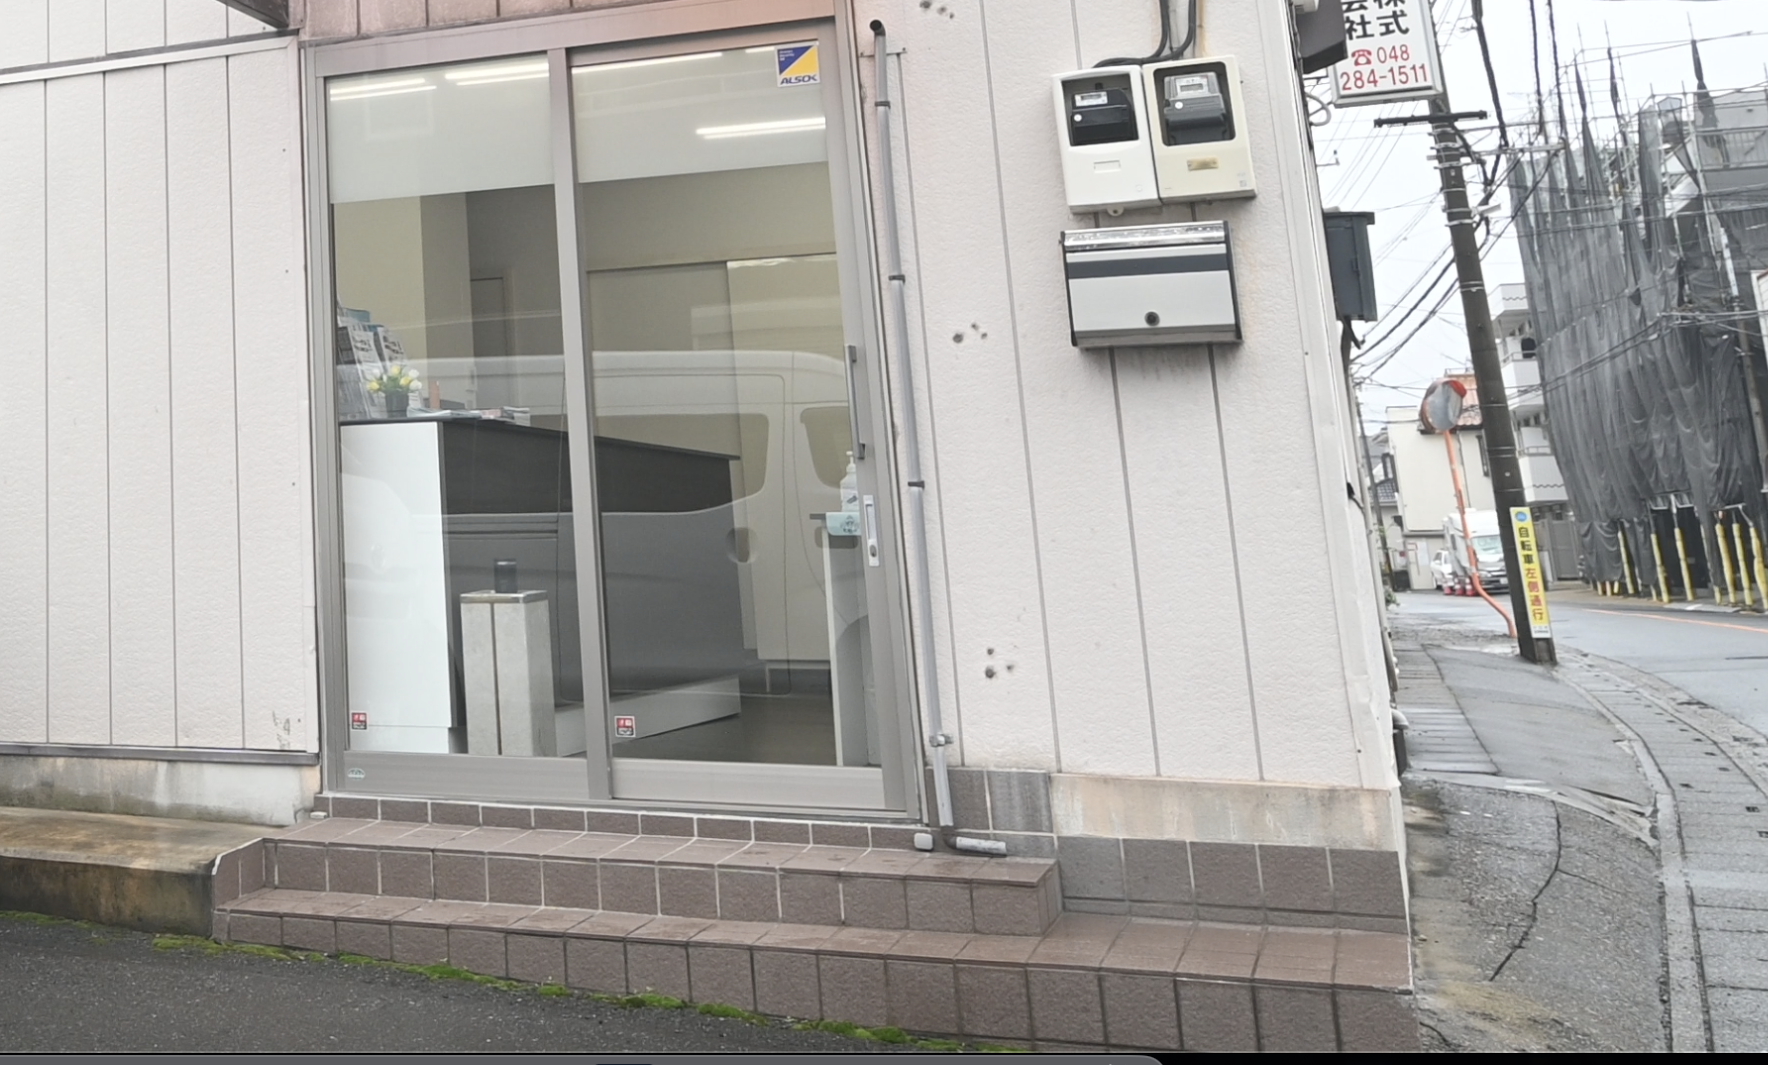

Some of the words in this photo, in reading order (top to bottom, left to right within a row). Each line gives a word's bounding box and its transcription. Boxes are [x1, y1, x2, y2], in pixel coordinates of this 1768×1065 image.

[1376, 43, 1410, 64] 048
[780, 74, 818, 86] ALSOK
[1339, 63, 1428, 91] 284-1511
